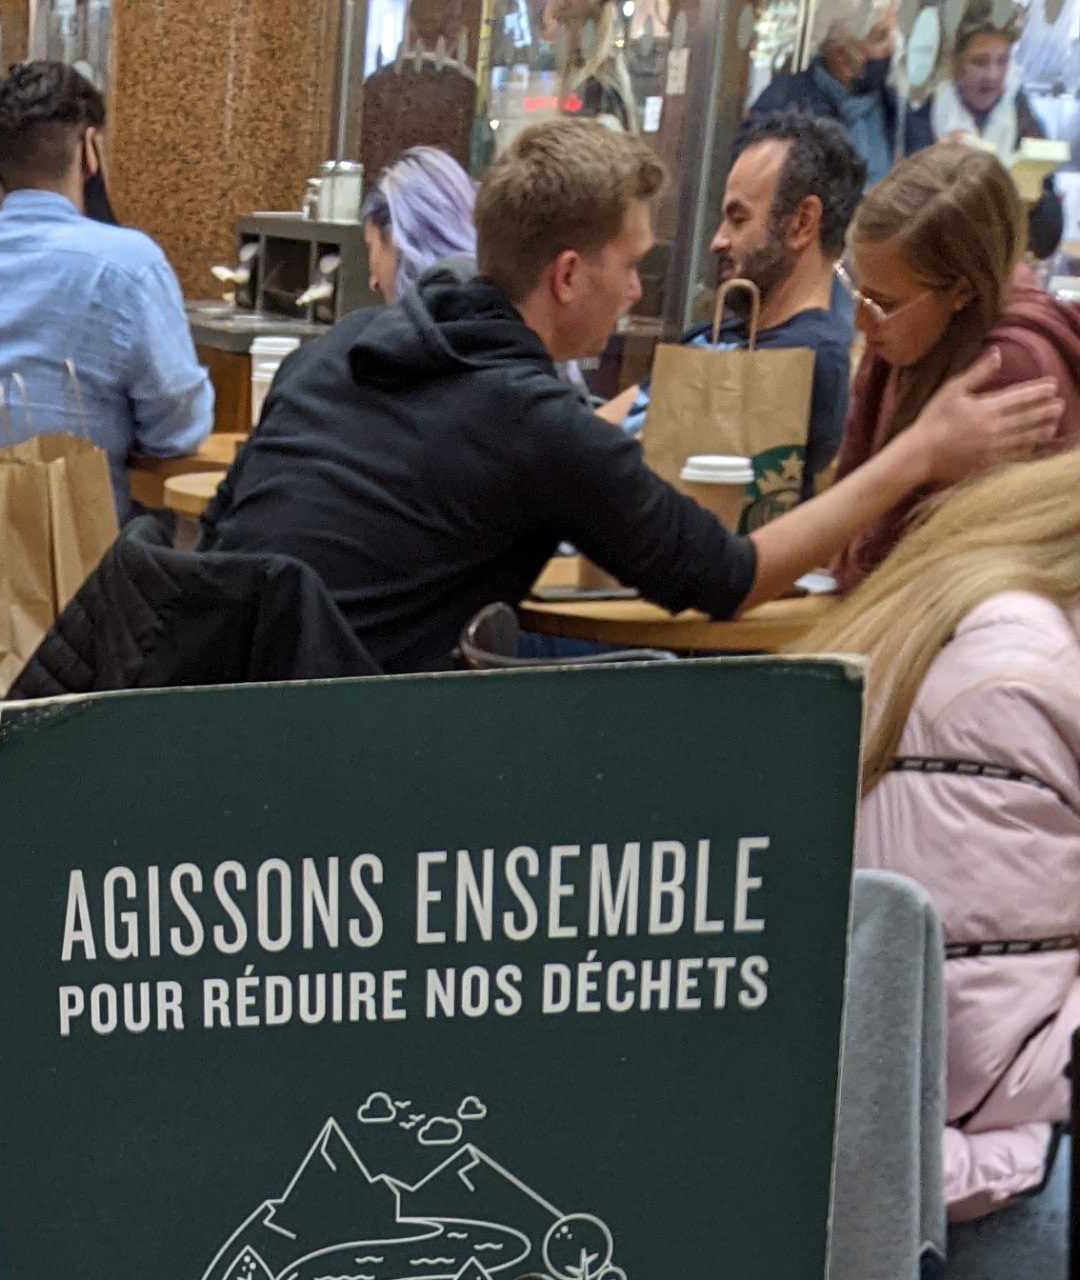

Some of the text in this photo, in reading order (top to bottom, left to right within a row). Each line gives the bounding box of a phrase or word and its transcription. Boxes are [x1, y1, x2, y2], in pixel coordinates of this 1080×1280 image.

[61, 837, 771, 961] AGISSONS ENSEMBLE
[59, 949, 770, 1036] POUR RÉDUIRE NOS DÉCHETS
